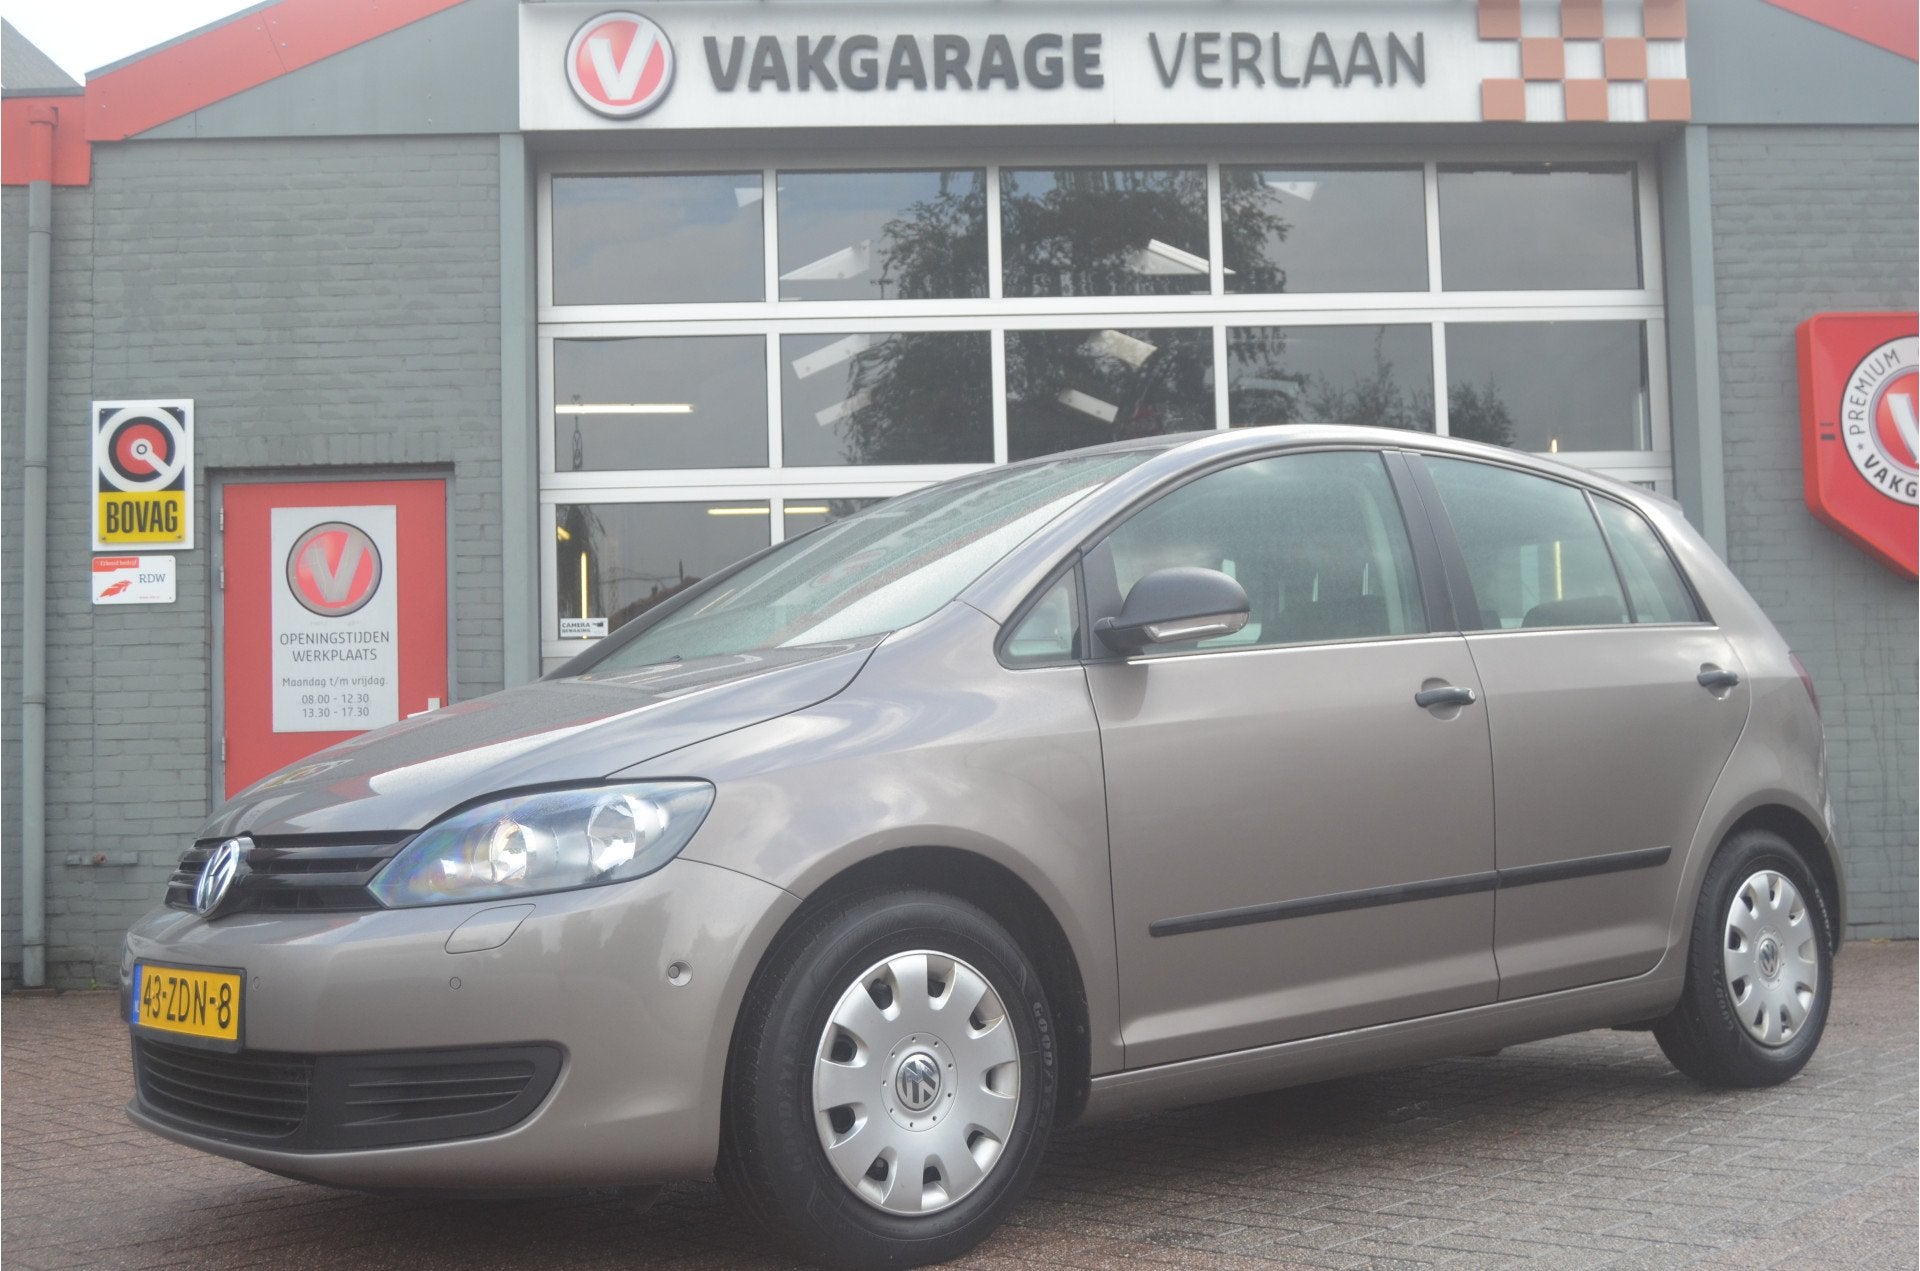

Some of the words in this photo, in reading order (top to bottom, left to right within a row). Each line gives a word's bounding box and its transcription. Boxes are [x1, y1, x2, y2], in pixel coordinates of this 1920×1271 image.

[702, 33, 1105, 92] VAKGARAGE
[1148, 31, 1427, 89] VERLAAN
[1849, 348, 1901, 436] PREMIUM
[106, 499, 178, 534] BOVAG
[139, 573, 166, 584] RDW
[279, 630, 391, 646] OPENINGSTIJDEN
[292, 648, 378, 662] WERKPLAATS
[282, 677, 327, 689] Maandag
[329, 676, 349, 687] t/m
[301, 694, 330, 705] 08.00
[302, 707, 330, 718] 13.30
[342, 706, 370, 717] 17.30
[143, 974, 232, 1029] 43-ZDN-8
